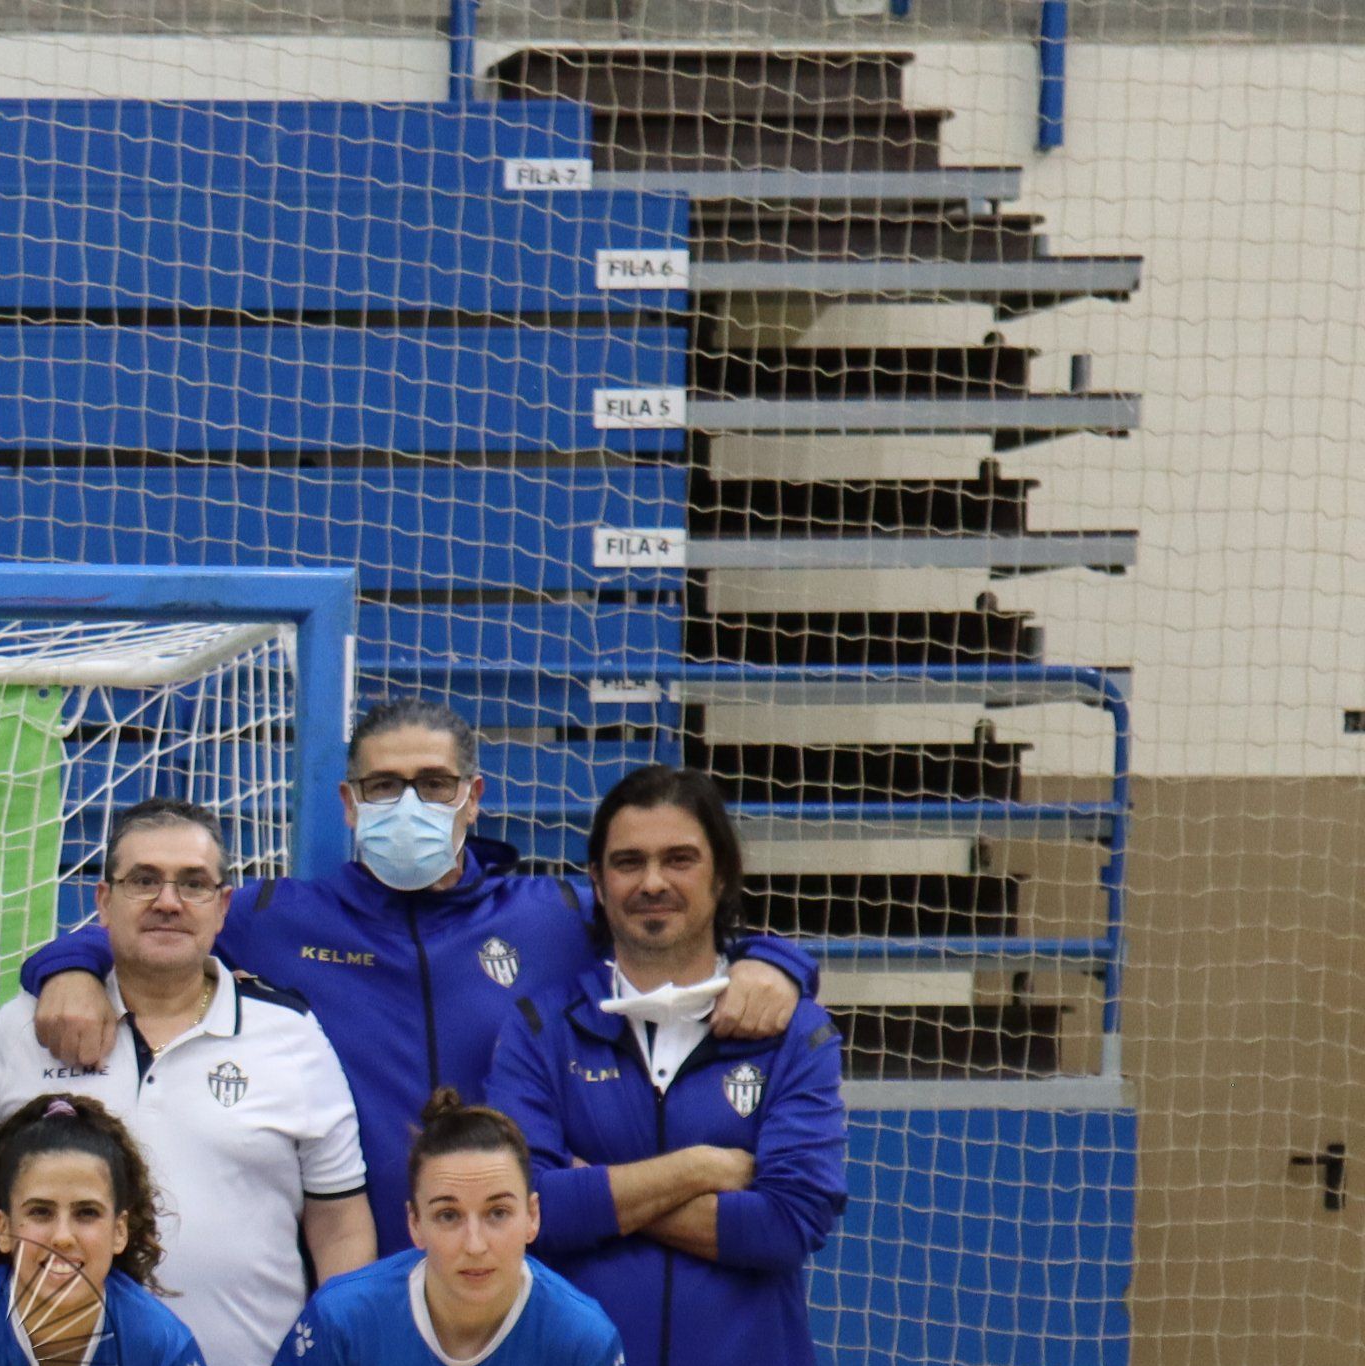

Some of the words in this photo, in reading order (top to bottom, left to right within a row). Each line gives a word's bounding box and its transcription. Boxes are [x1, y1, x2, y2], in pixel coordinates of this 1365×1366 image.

[517, 168, 560, 184] FILA
[568, 169, 578, 184] 7
[608, 259, 655, 276] FILA
[662, 260, 674, 276] 6
[607, 399, 651, 416] FILA
[660, 399, 671, 416] 5
[607, 537, 651, 555] FILA
[657, 536, 669, 555] 4
[300, 945, 376, 968] KELME
[43, 1065, 110, 1079] KELME
